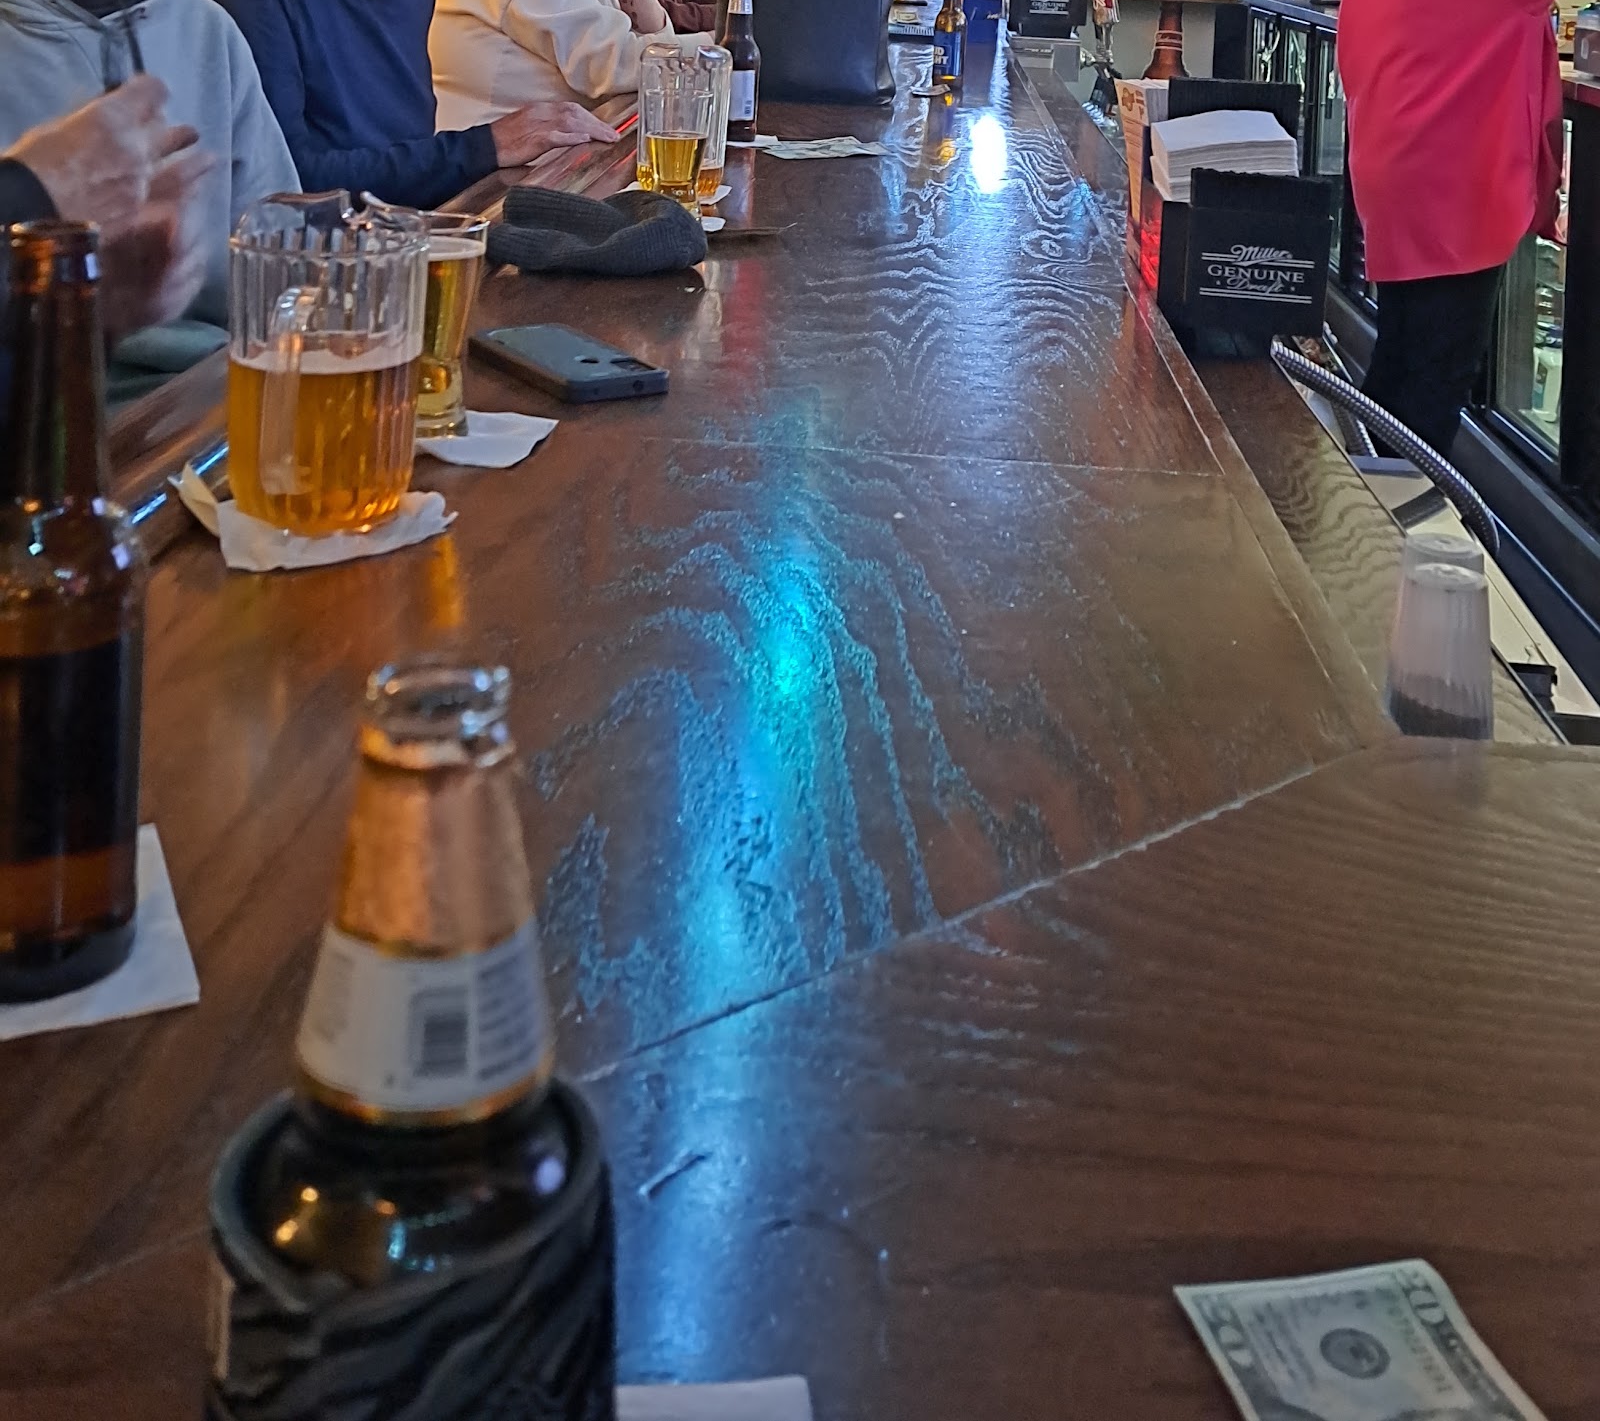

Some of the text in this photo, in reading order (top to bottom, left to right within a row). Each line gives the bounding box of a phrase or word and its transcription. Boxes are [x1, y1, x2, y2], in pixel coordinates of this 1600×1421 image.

[1230, 244, 1292, 264] Miller
[1207, 264, 1305, 283] GENUINE
[1226, 277, 1285, 295] Draft
